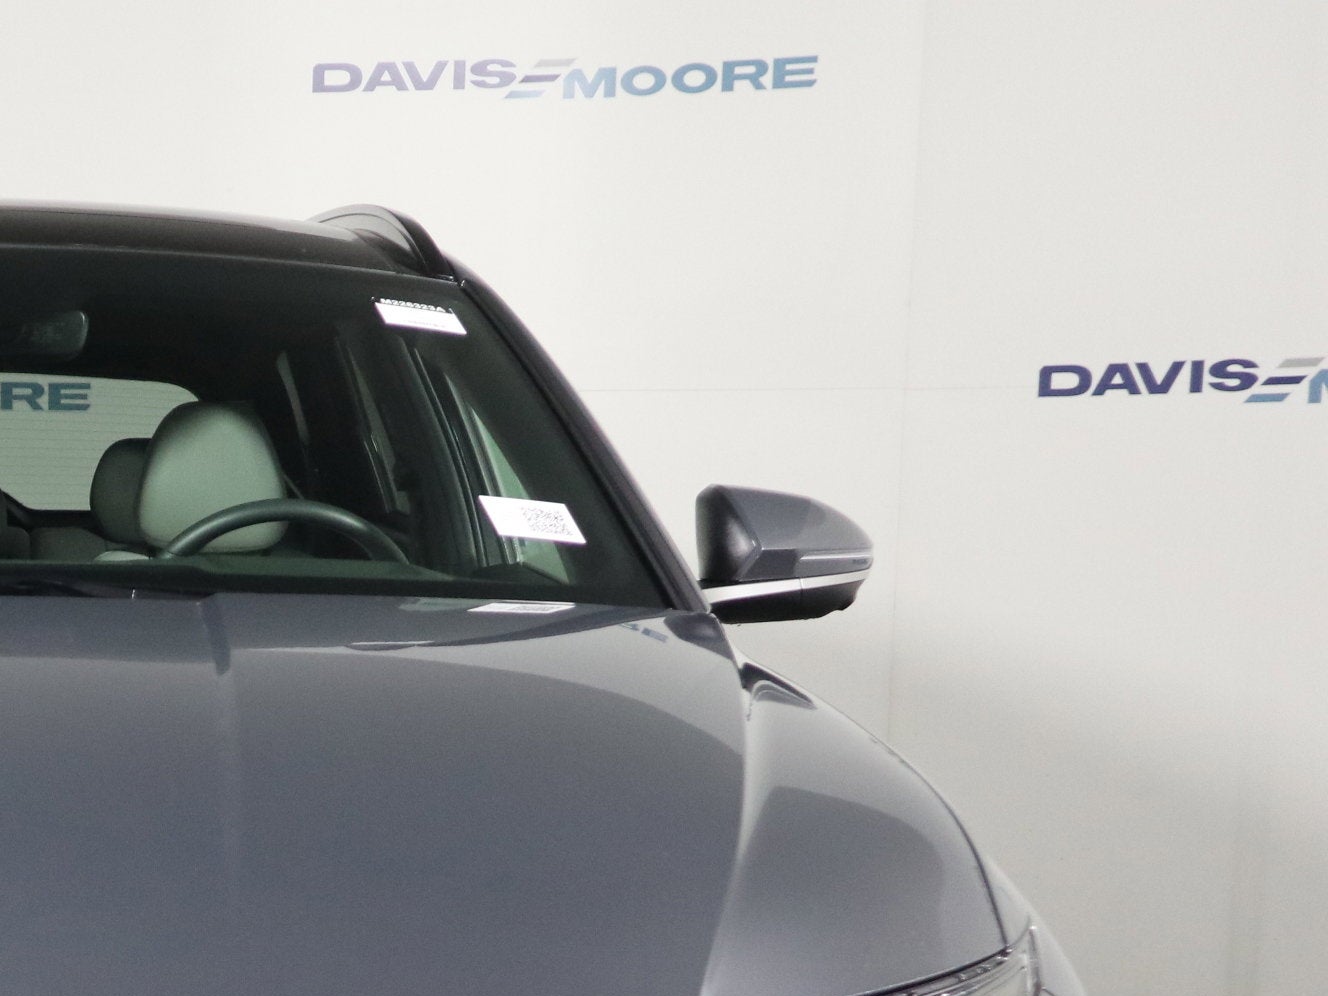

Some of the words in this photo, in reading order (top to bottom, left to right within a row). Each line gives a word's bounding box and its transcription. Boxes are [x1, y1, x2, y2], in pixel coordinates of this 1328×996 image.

[312, 58, 517, 93] DAVIS
[562, 55, 819, 100] MOORE
[1038, 358, 1260, 398] DAVIS
